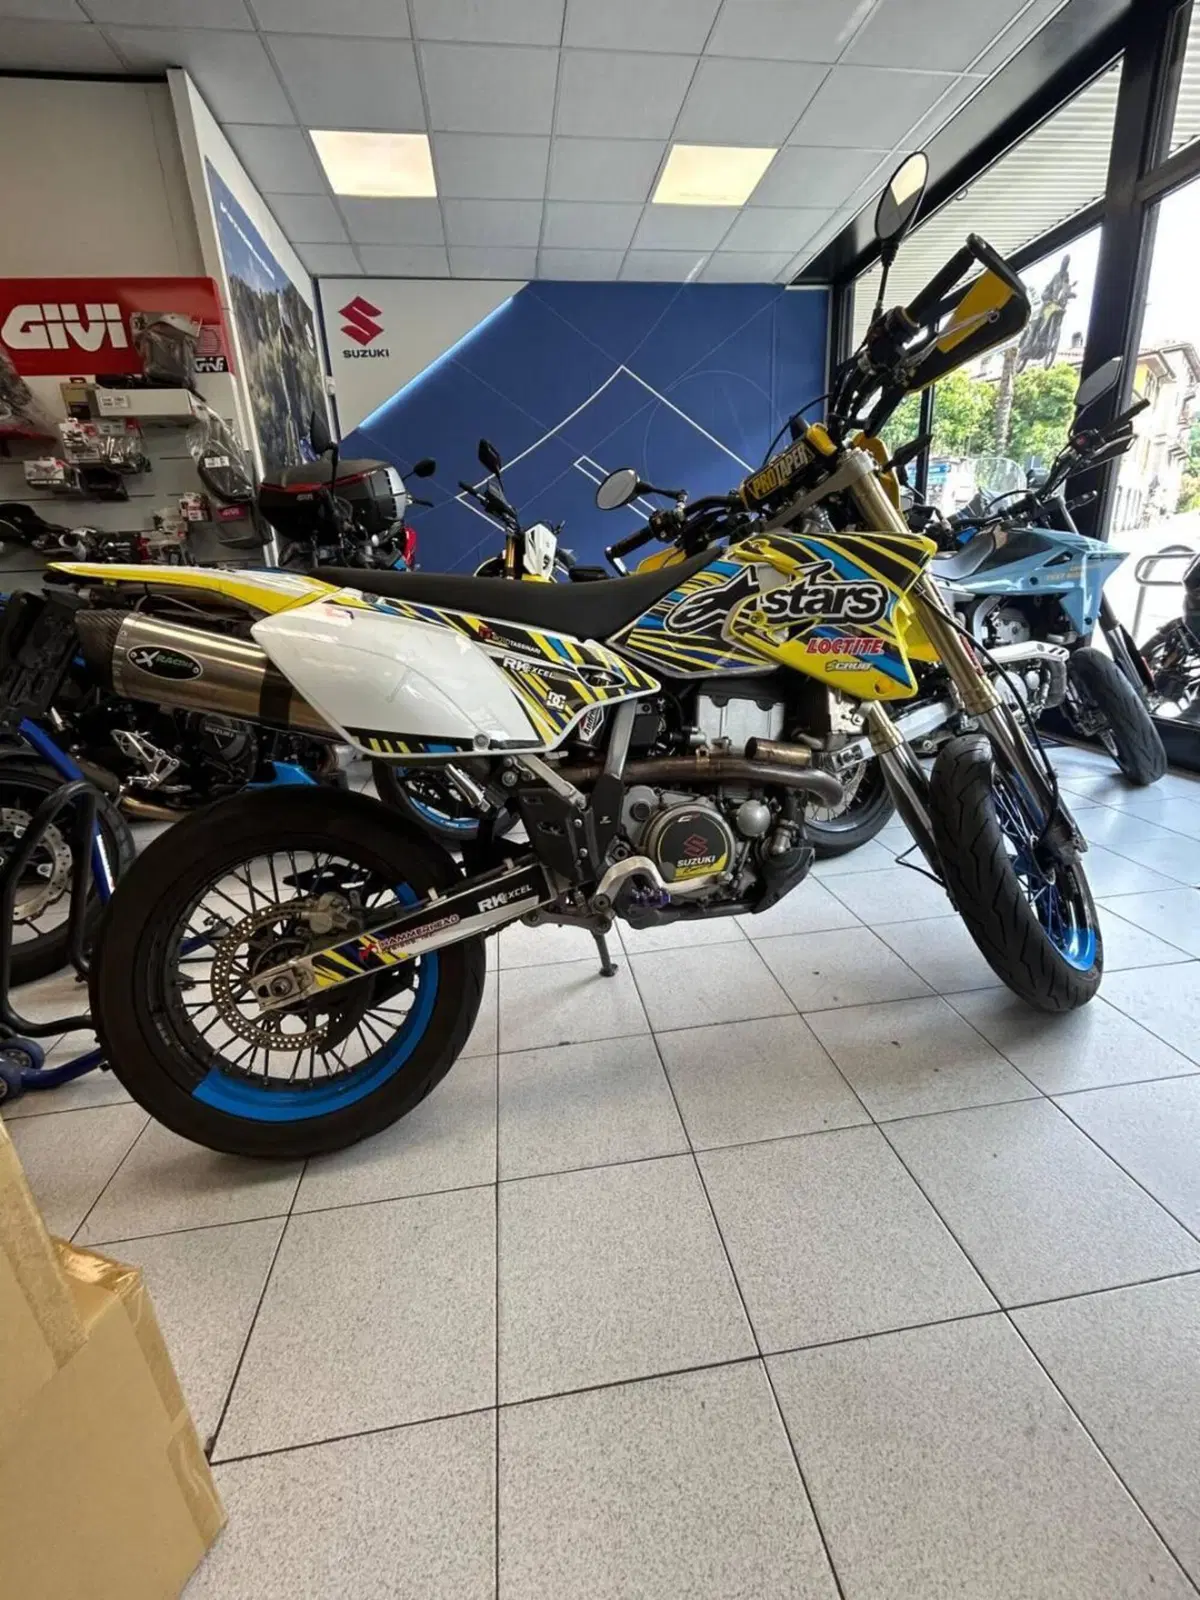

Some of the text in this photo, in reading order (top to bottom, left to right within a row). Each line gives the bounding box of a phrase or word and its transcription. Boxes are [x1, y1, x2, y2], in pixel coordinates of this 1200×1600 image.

[1, 303, 129, 352] GIVI
[342, 348, 390, 359] SUZUKI
[805, 637, 885, 655] LOCTITE
[676, 854, 717, 868] SUZUKI
